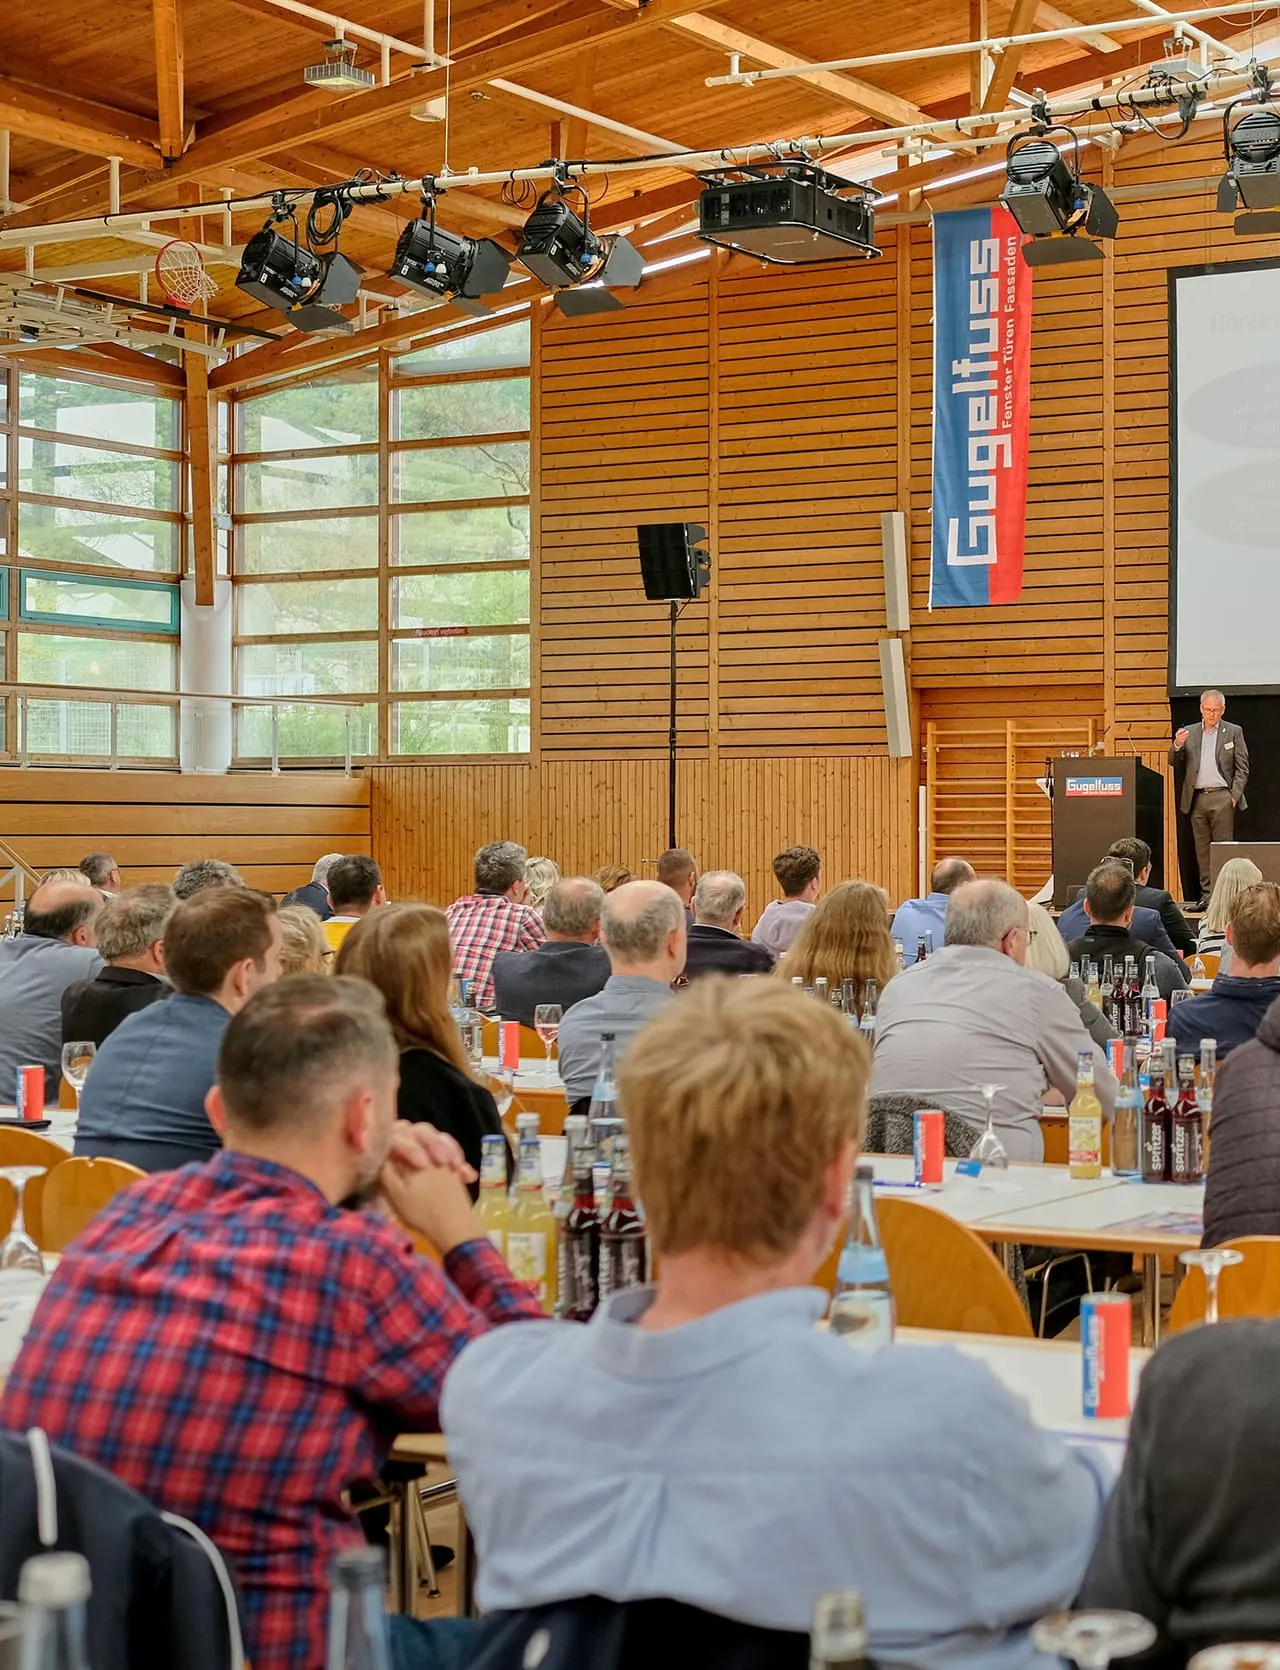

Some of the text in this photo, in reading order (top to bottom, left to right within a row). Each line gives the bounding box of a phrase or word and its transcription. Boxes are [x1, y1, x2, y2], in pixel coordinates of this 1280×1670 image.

[1001, 235, 1018, 429] Fenster Türen Fassaden
[947, 237, 1013, 566] Gugelfuss
[1067, 780, 1120, 794] Gugelfuss
[1148, 1124, 1162, 1171] spritzer
[1173, 1124, 1185, 1172] spritzer
